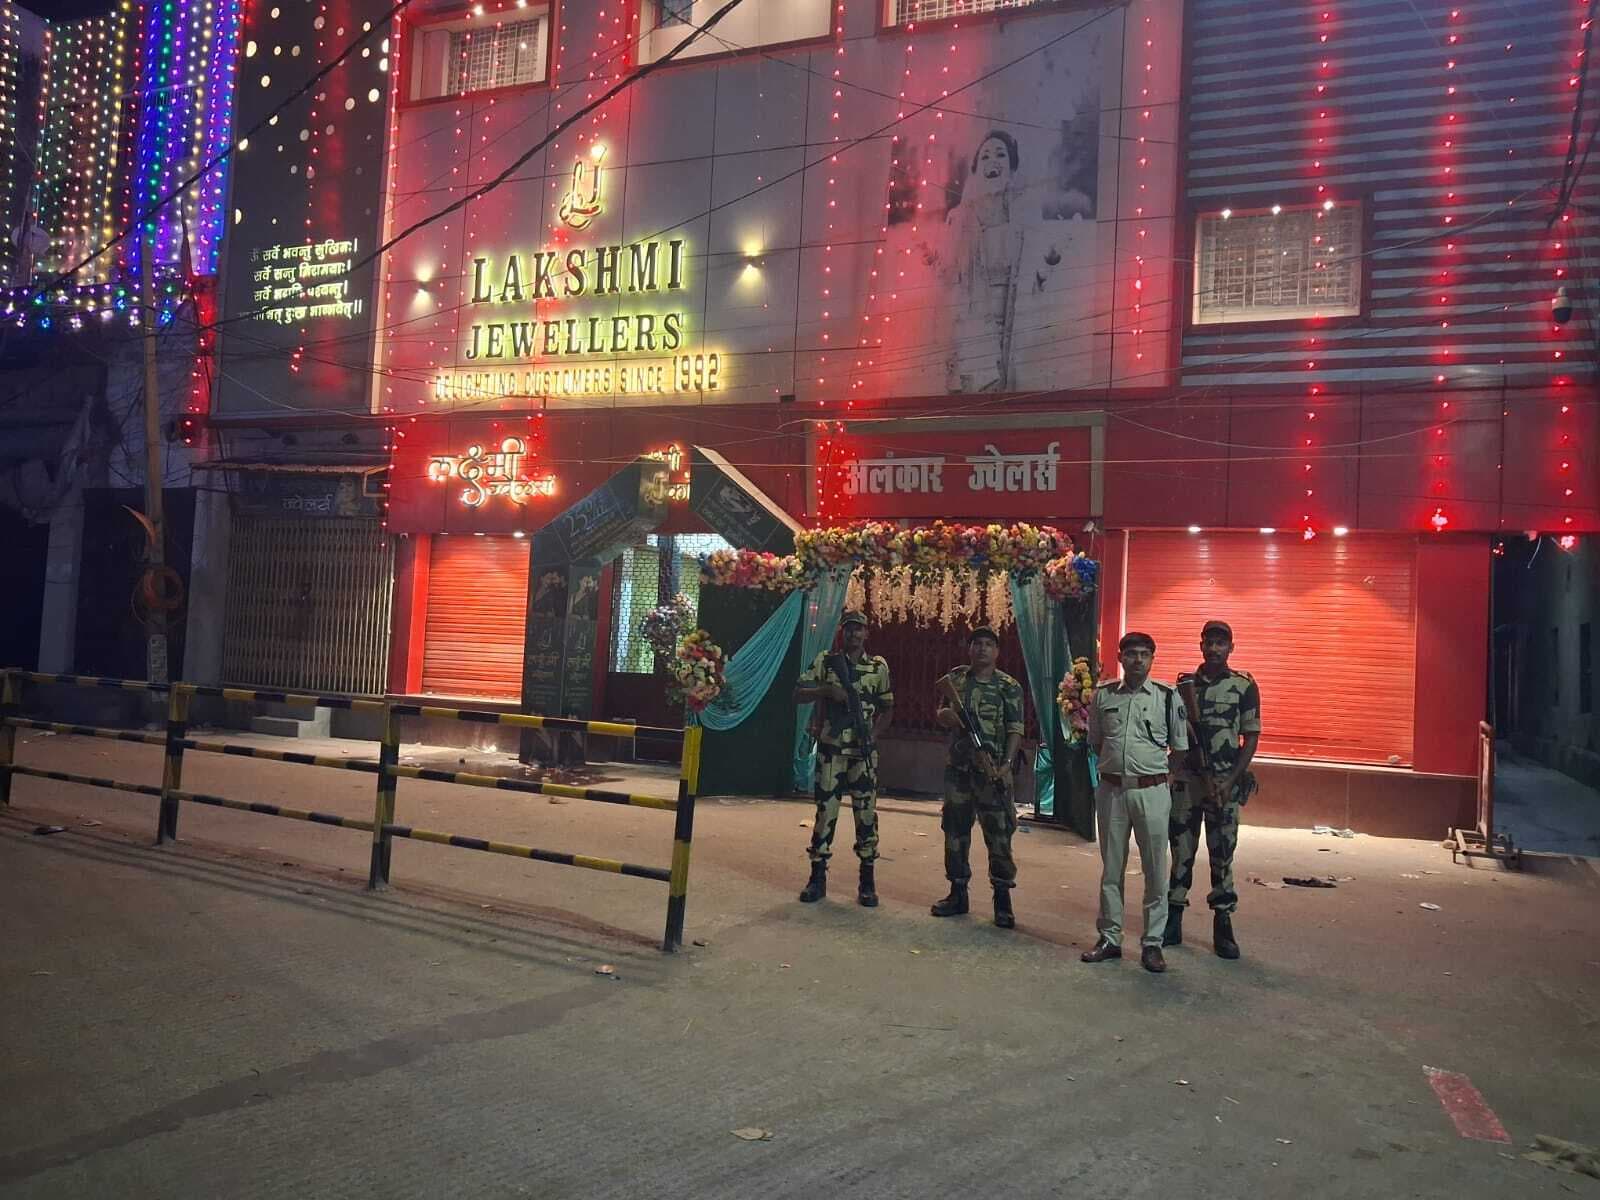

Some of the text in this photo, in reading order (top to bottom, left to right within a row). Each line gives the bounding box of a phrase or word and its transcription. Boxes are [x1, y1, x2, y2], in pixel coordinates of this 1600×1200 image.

[471, 240, 684, 304] LAKSHMI
[466, 313, 684, 361] JEWELLERS
[435, 352, 721, 400] DELIGHTING CUSTOMERS SINCE 1992
[842, 450, 946, 495] अलंकार
